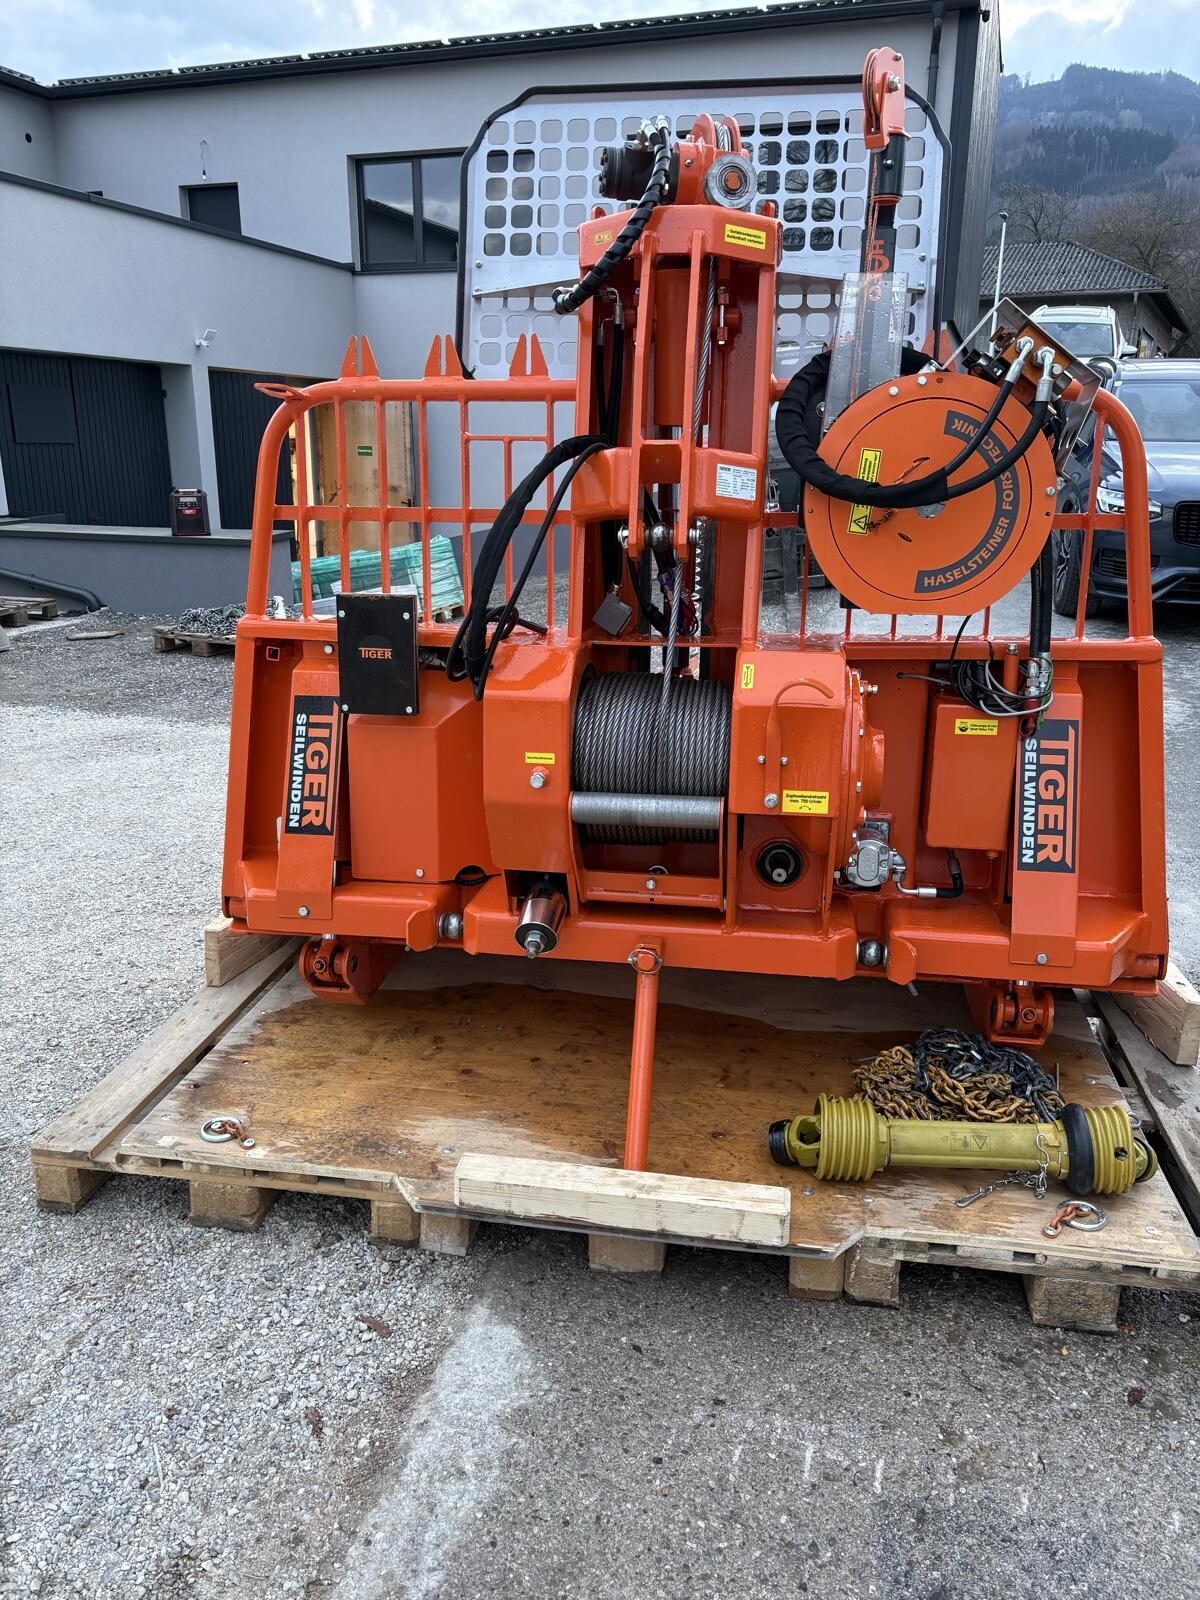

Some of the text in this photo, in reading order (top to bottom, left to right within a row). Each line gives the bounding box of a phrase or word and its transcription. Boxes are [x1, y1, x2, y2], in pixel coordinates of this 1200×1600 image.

[923, 518, 1010, 588] HASELSTEINER
[358, 647, 392, 659] TIGER
[288, 713, 307, 828] SEILWINDEN
[301, 700, 339, 832] TIGER
[1021, 738, 1037, 864] SEILWINDEN
[1036, 725, 1075, 868] TIGER
